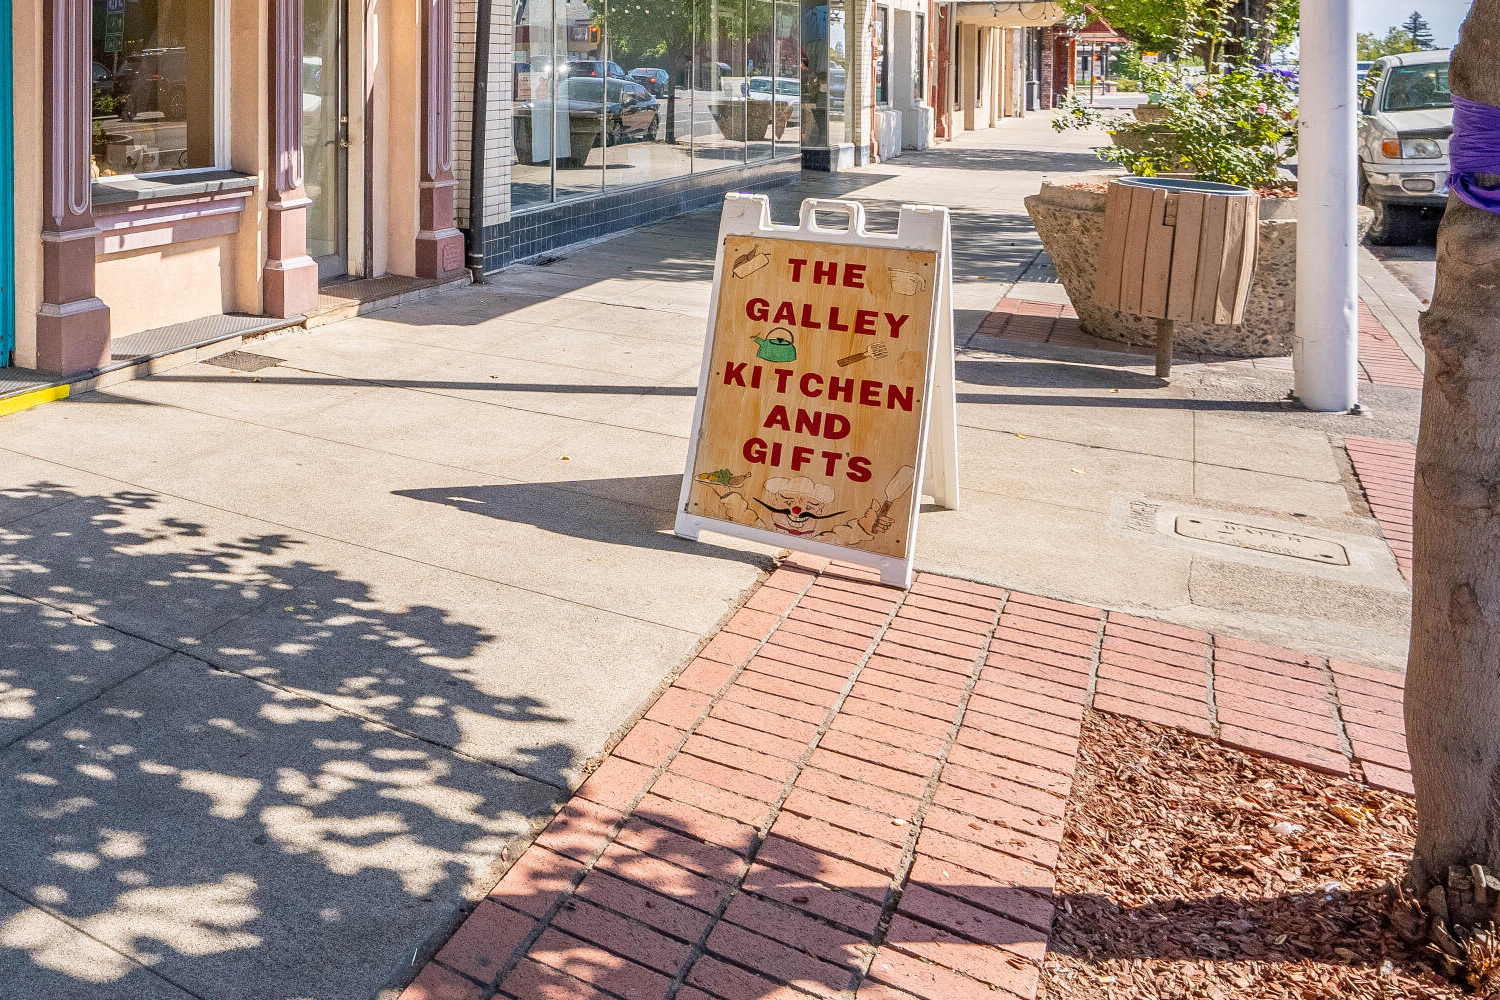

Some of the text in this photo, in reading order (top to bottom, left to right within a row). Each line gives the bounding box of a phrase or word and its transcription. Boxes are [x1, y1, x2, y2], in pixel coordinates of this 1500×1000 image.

[788, 258, 867, 289] THE
[746, 297, 910, 339] GALLEY
[723, 361, 914, 412] KITCHEN
[763, 404, 851, 440] AND
[742, 437, 873, 483] GIFTS
